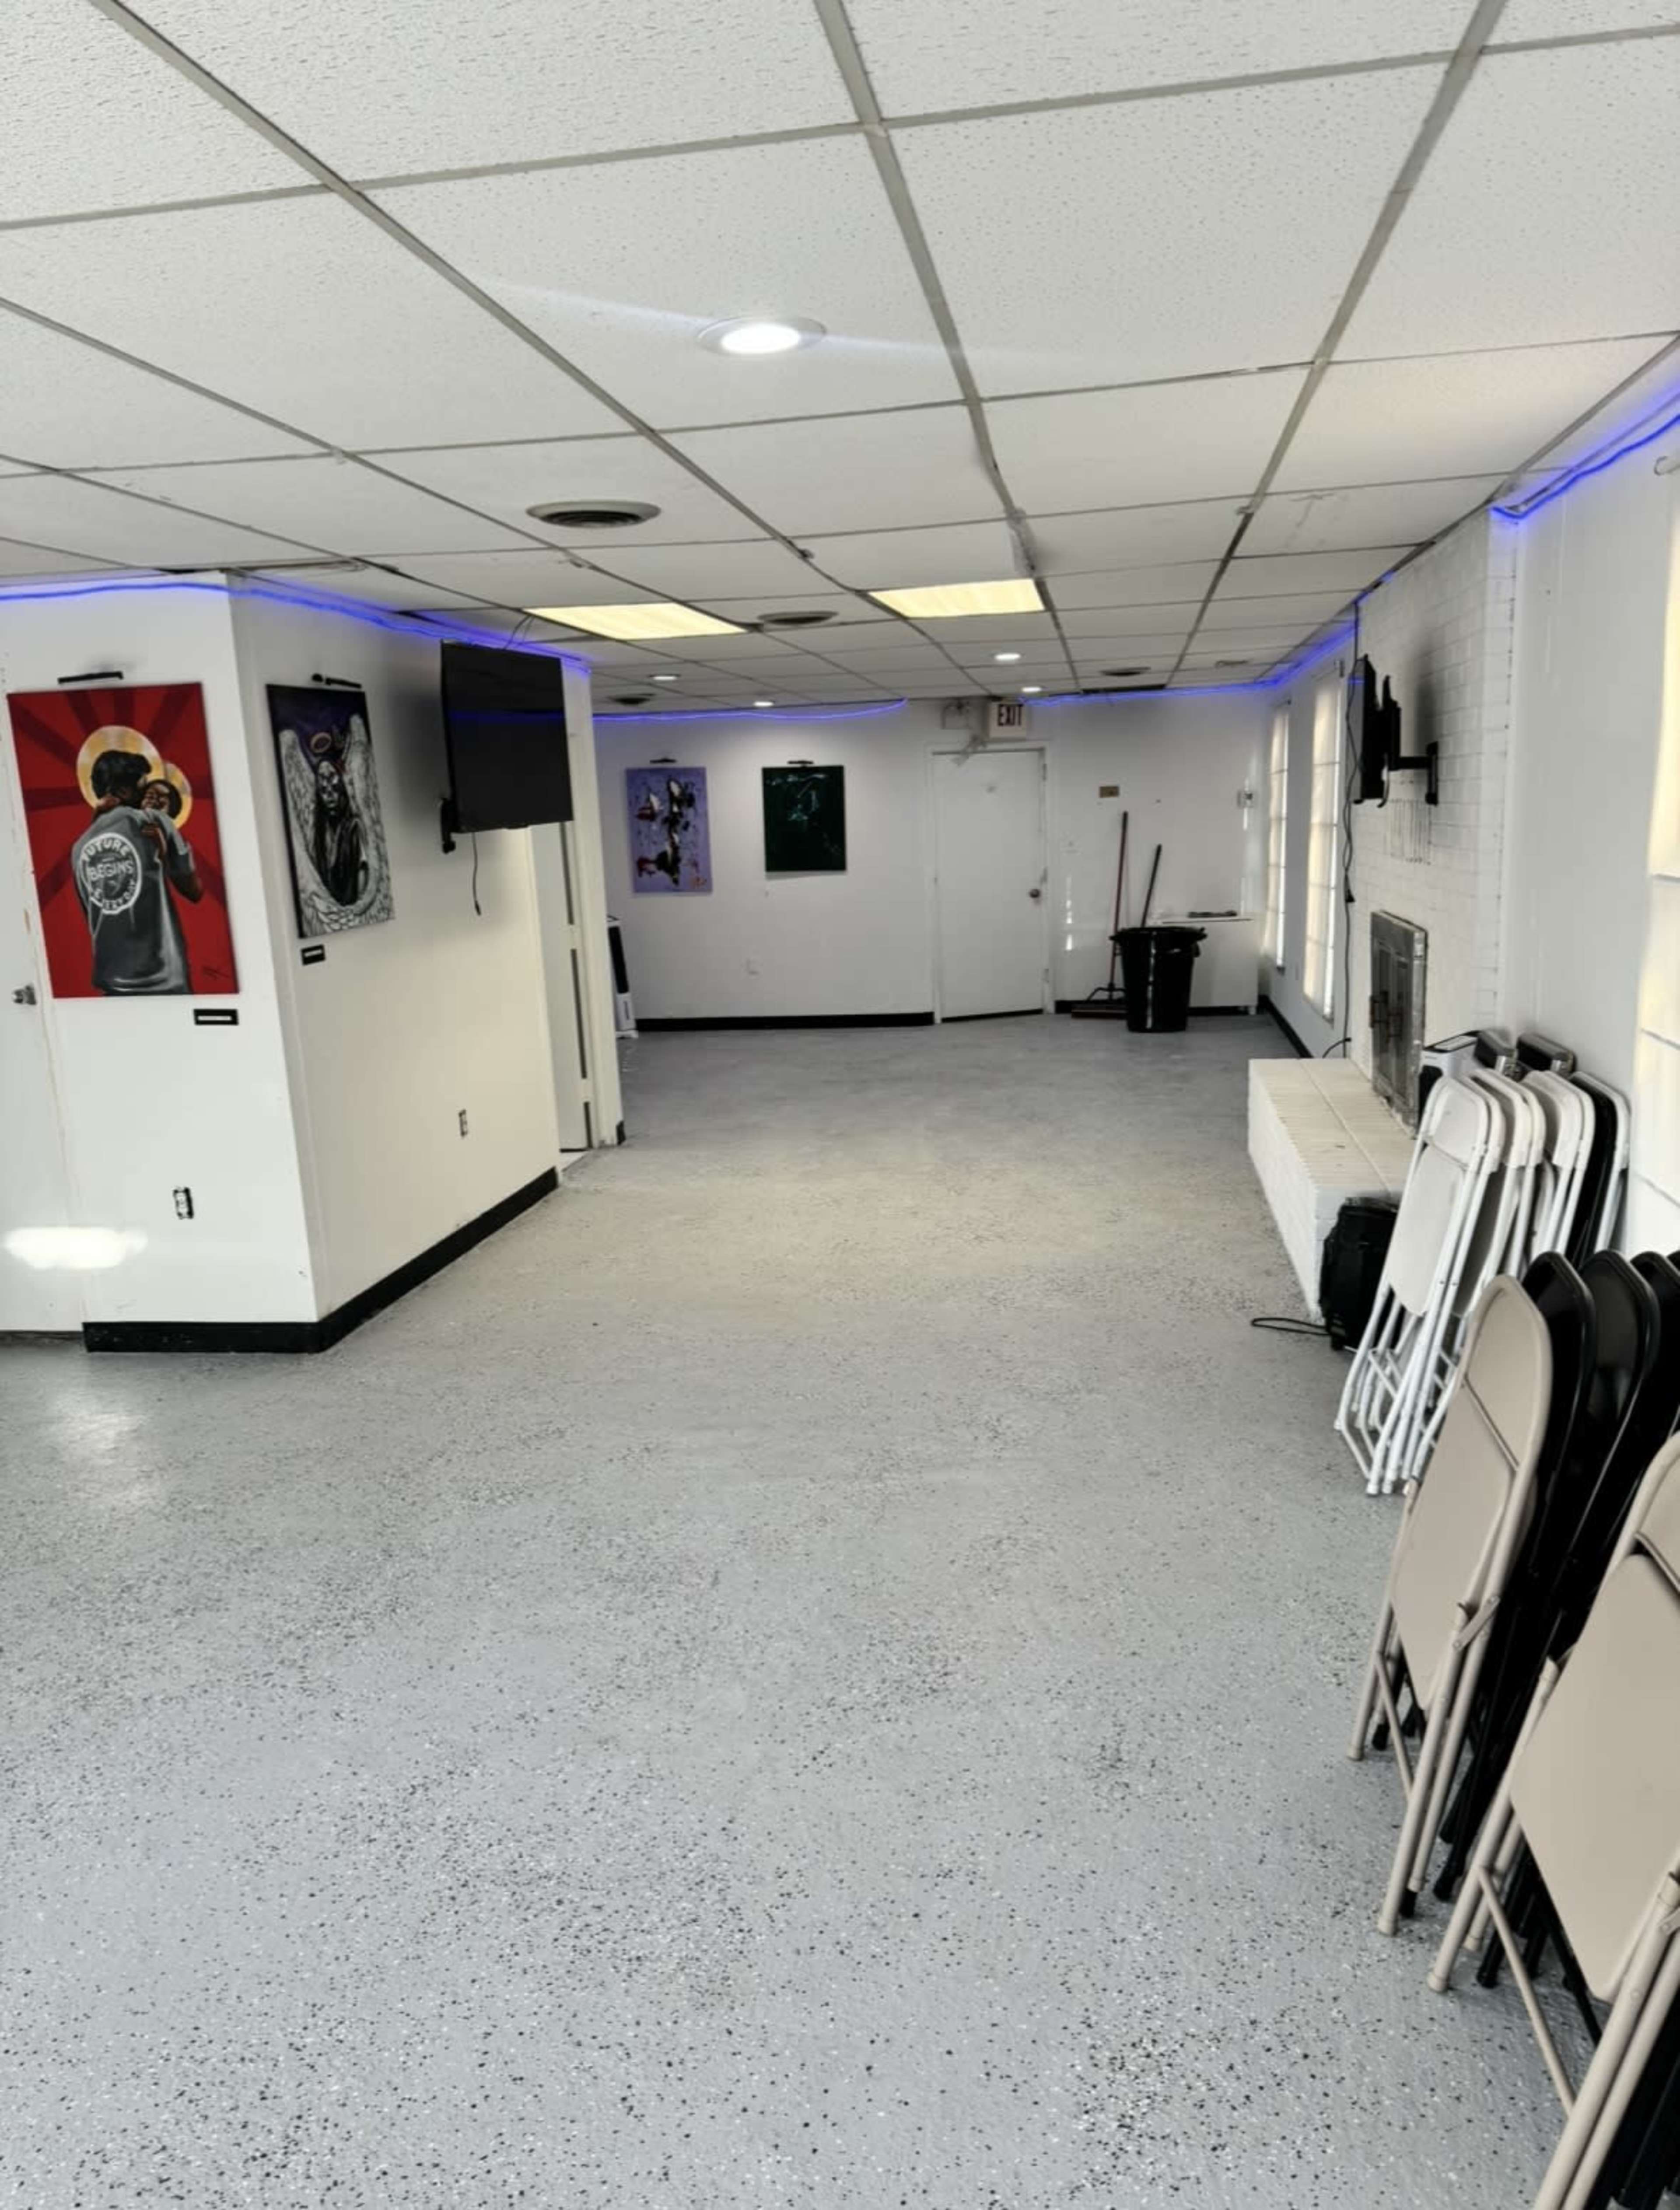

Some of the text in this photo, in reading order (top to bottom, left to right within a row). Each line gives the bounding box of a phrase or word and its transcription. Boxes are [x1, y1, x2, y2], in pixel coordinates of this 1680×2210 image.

[998, 704, 1023, 726] EXIT
[81, 839, 131, 862] FUTURE
[88, 860, 133, 881] BEGINS
